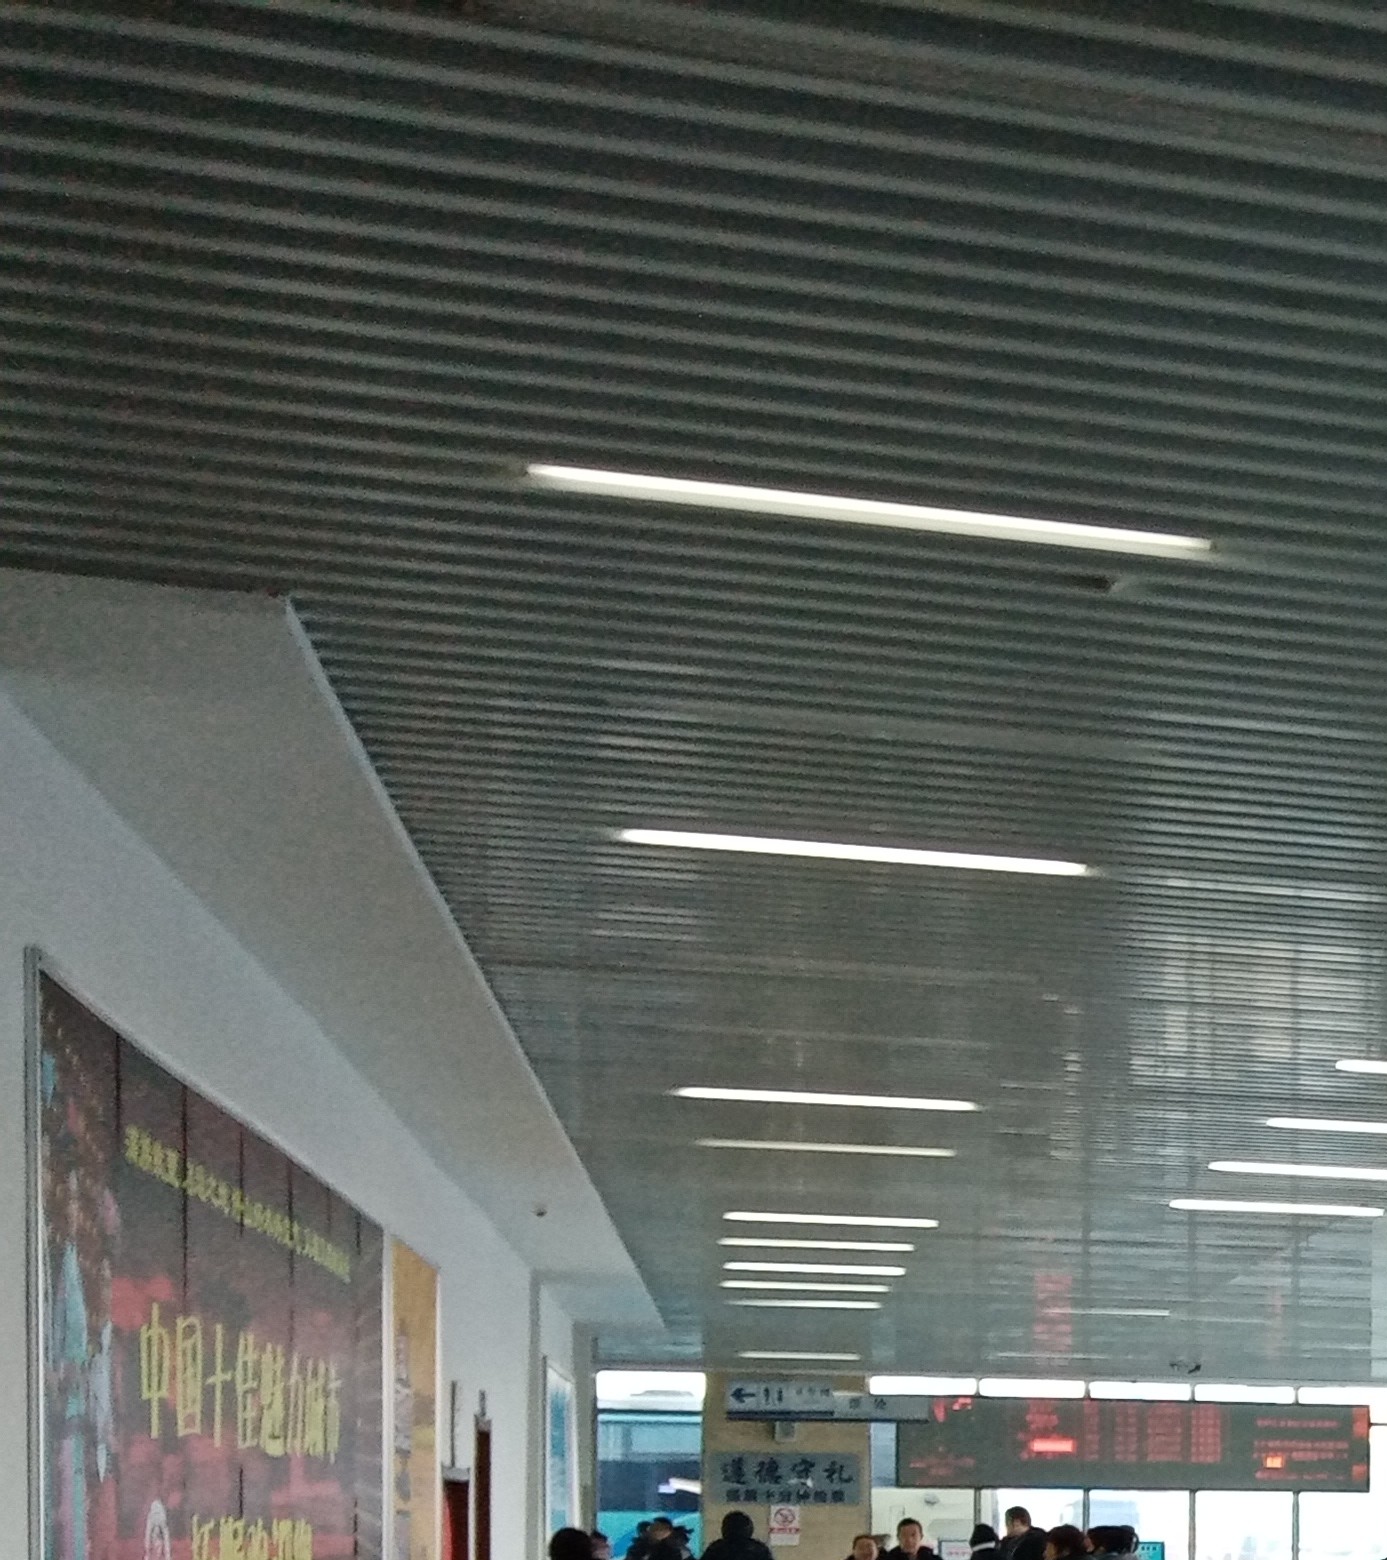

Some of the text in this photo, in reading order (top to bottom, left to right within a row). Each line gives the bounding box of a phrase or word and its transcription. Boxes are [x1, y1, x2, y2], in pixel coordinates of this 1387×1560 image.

[139, 1301, 342, 1465] 中国十佳魅力城市
